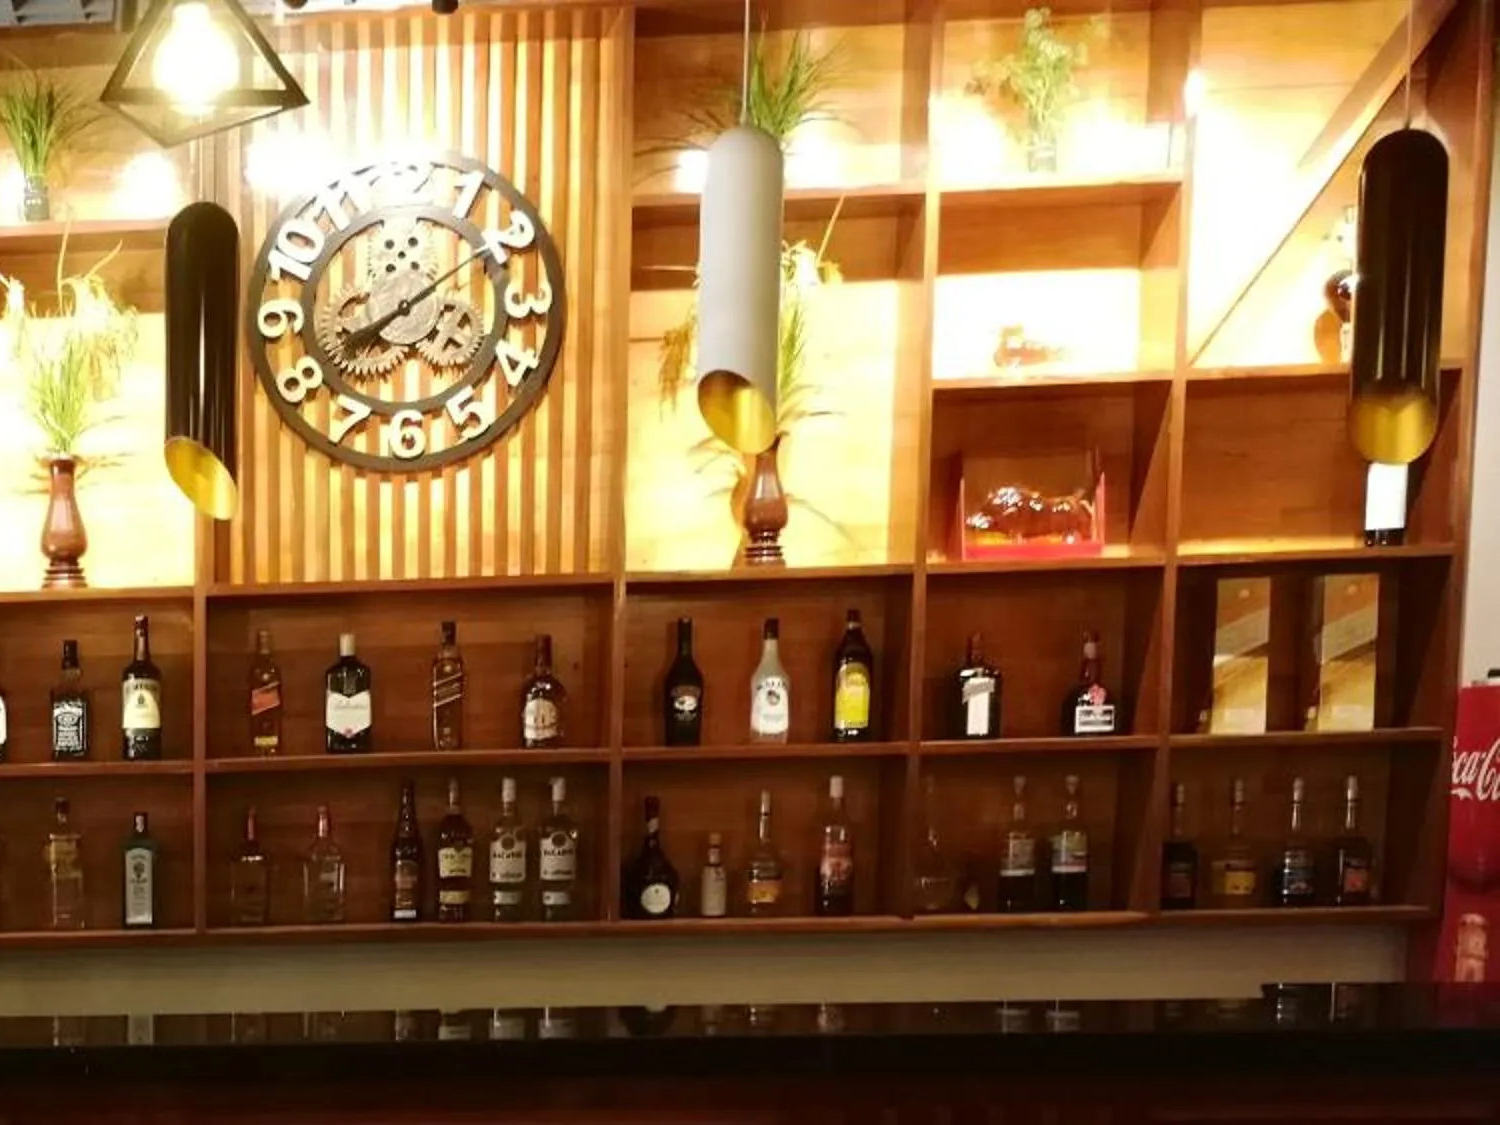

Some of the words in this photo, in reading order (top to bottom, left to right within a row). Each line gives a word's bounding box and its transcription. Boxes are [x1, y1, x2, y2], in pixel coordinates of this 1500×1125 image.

[452, 170, 486, 220] 1
[267, 218, 326, 281] 10
[481, 210, 536, 266] 2
[257, 298, 305, 339] 9
[504, 281, 553, 320] 3
[276, 356, 324, 404] 8
[494, 338, 541, 388] 4
[328, 395, 372, 445] 7
[389, 409, 426, 460] 6
[446, 386, 497, 440] 5
